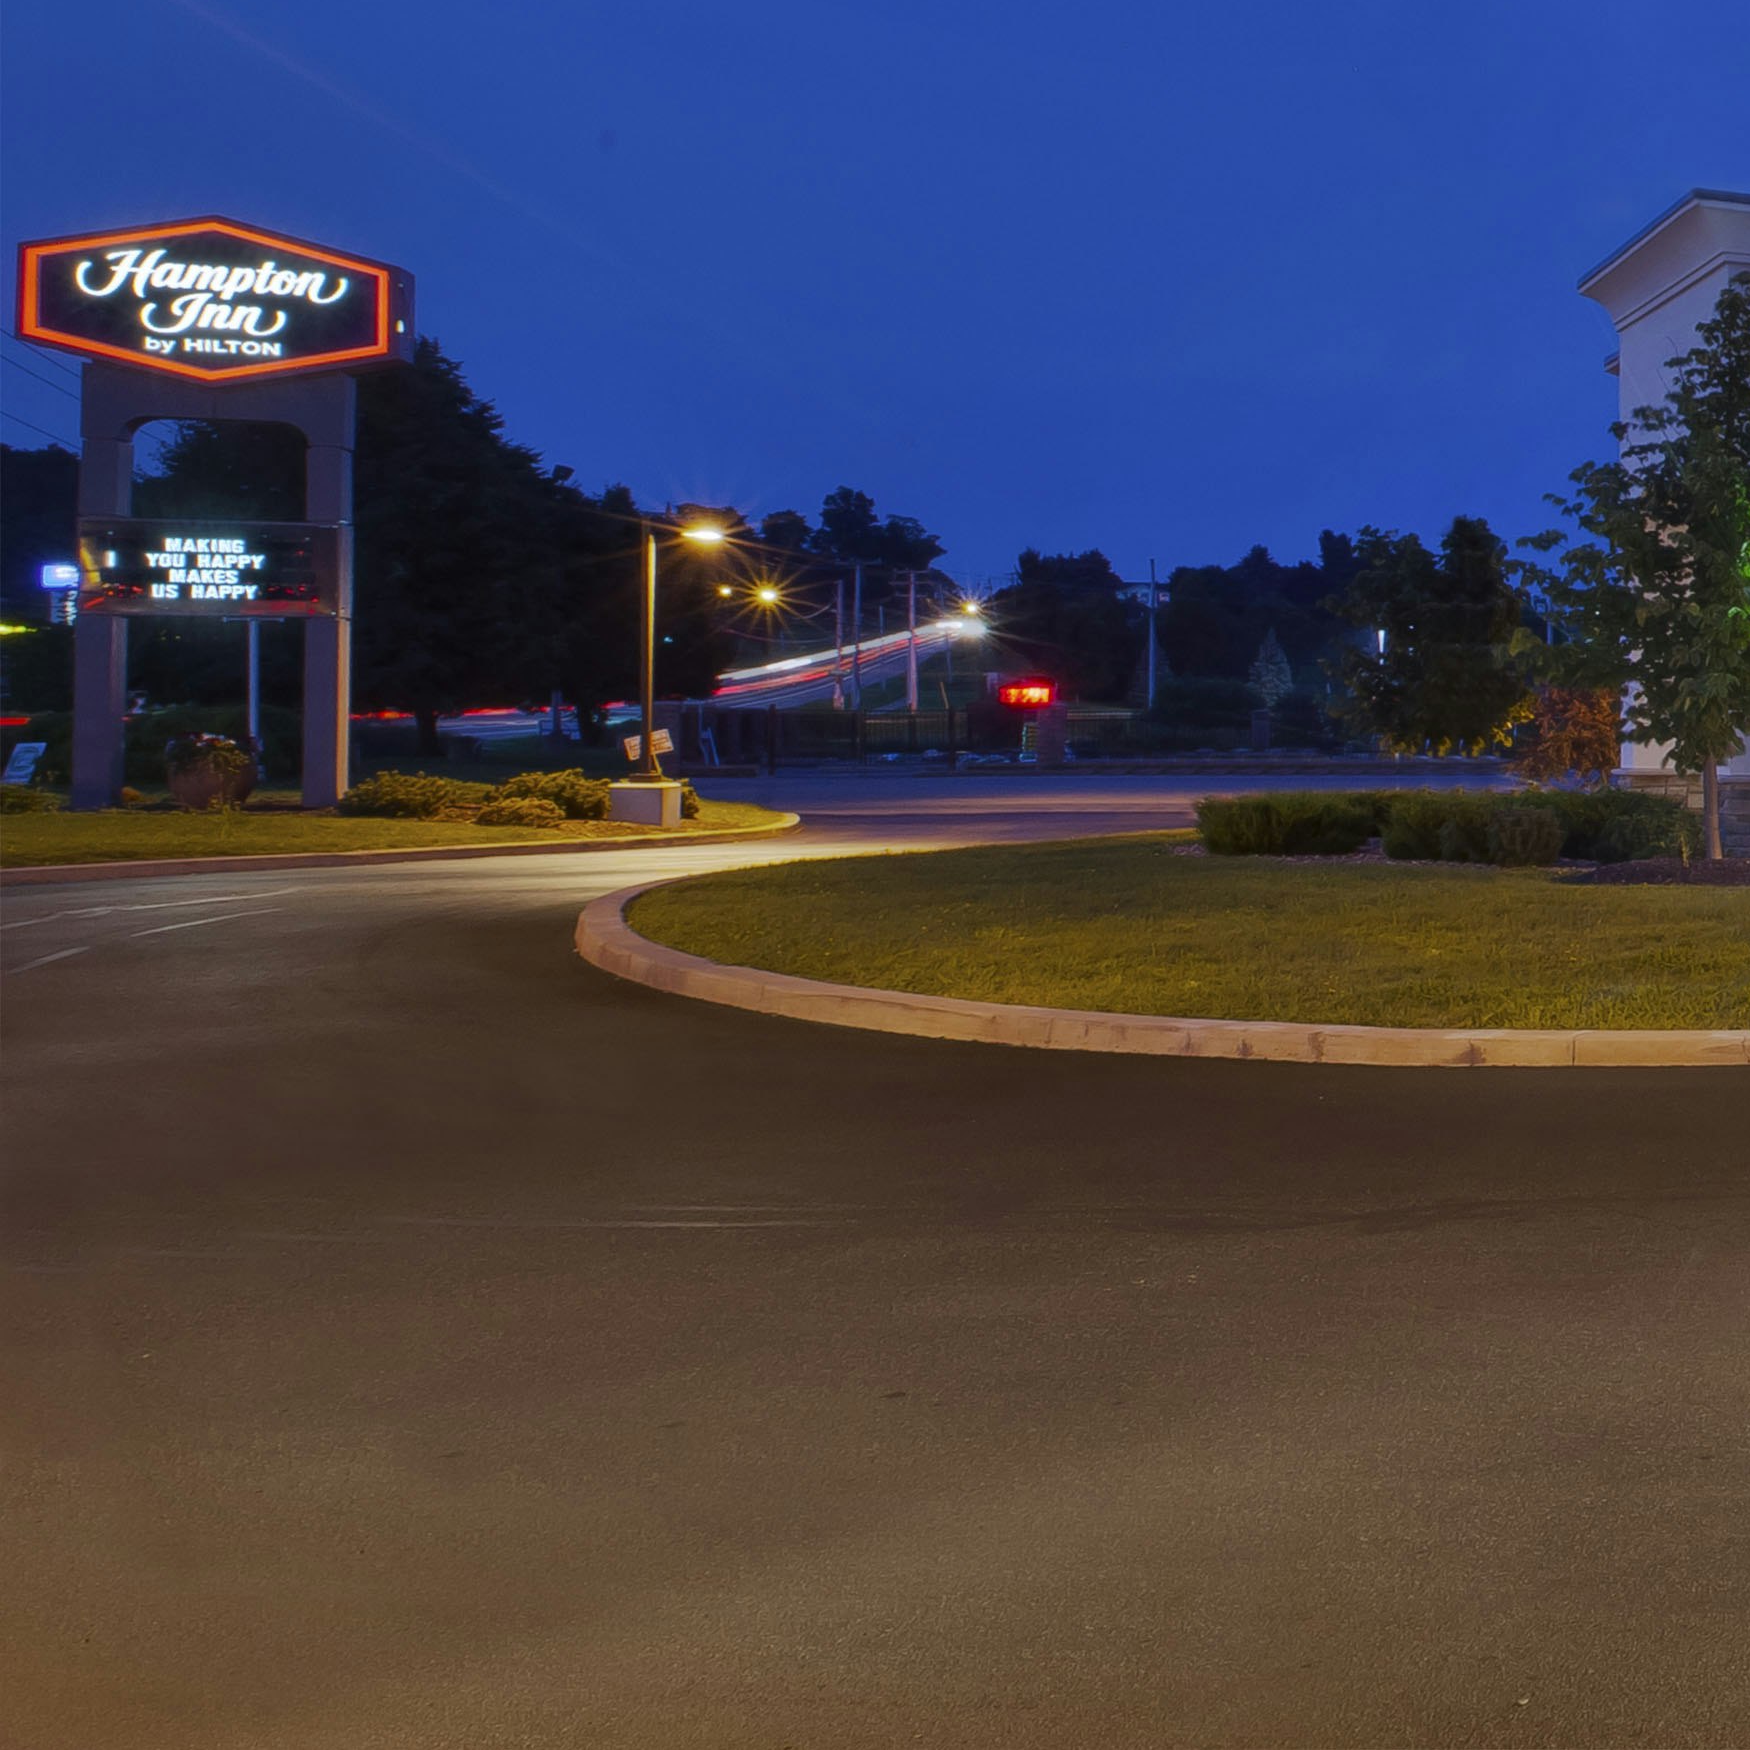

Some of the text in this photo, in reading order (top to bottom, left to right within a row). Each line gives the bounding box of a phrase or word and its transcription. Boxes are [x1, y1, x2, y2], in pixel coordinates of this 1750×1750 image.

[76, 249, 348, 304] Hampton
[139, 292, 287, 337] Inn
[144, 336, 282, 357] by HILTON
[164, 537, 246, 554] MAKING
[145, 552, 266, 570] YOU HAPPY
[167, 568, 240, 584] MAKES
[151, 583, 259, 600] US HAPPY
